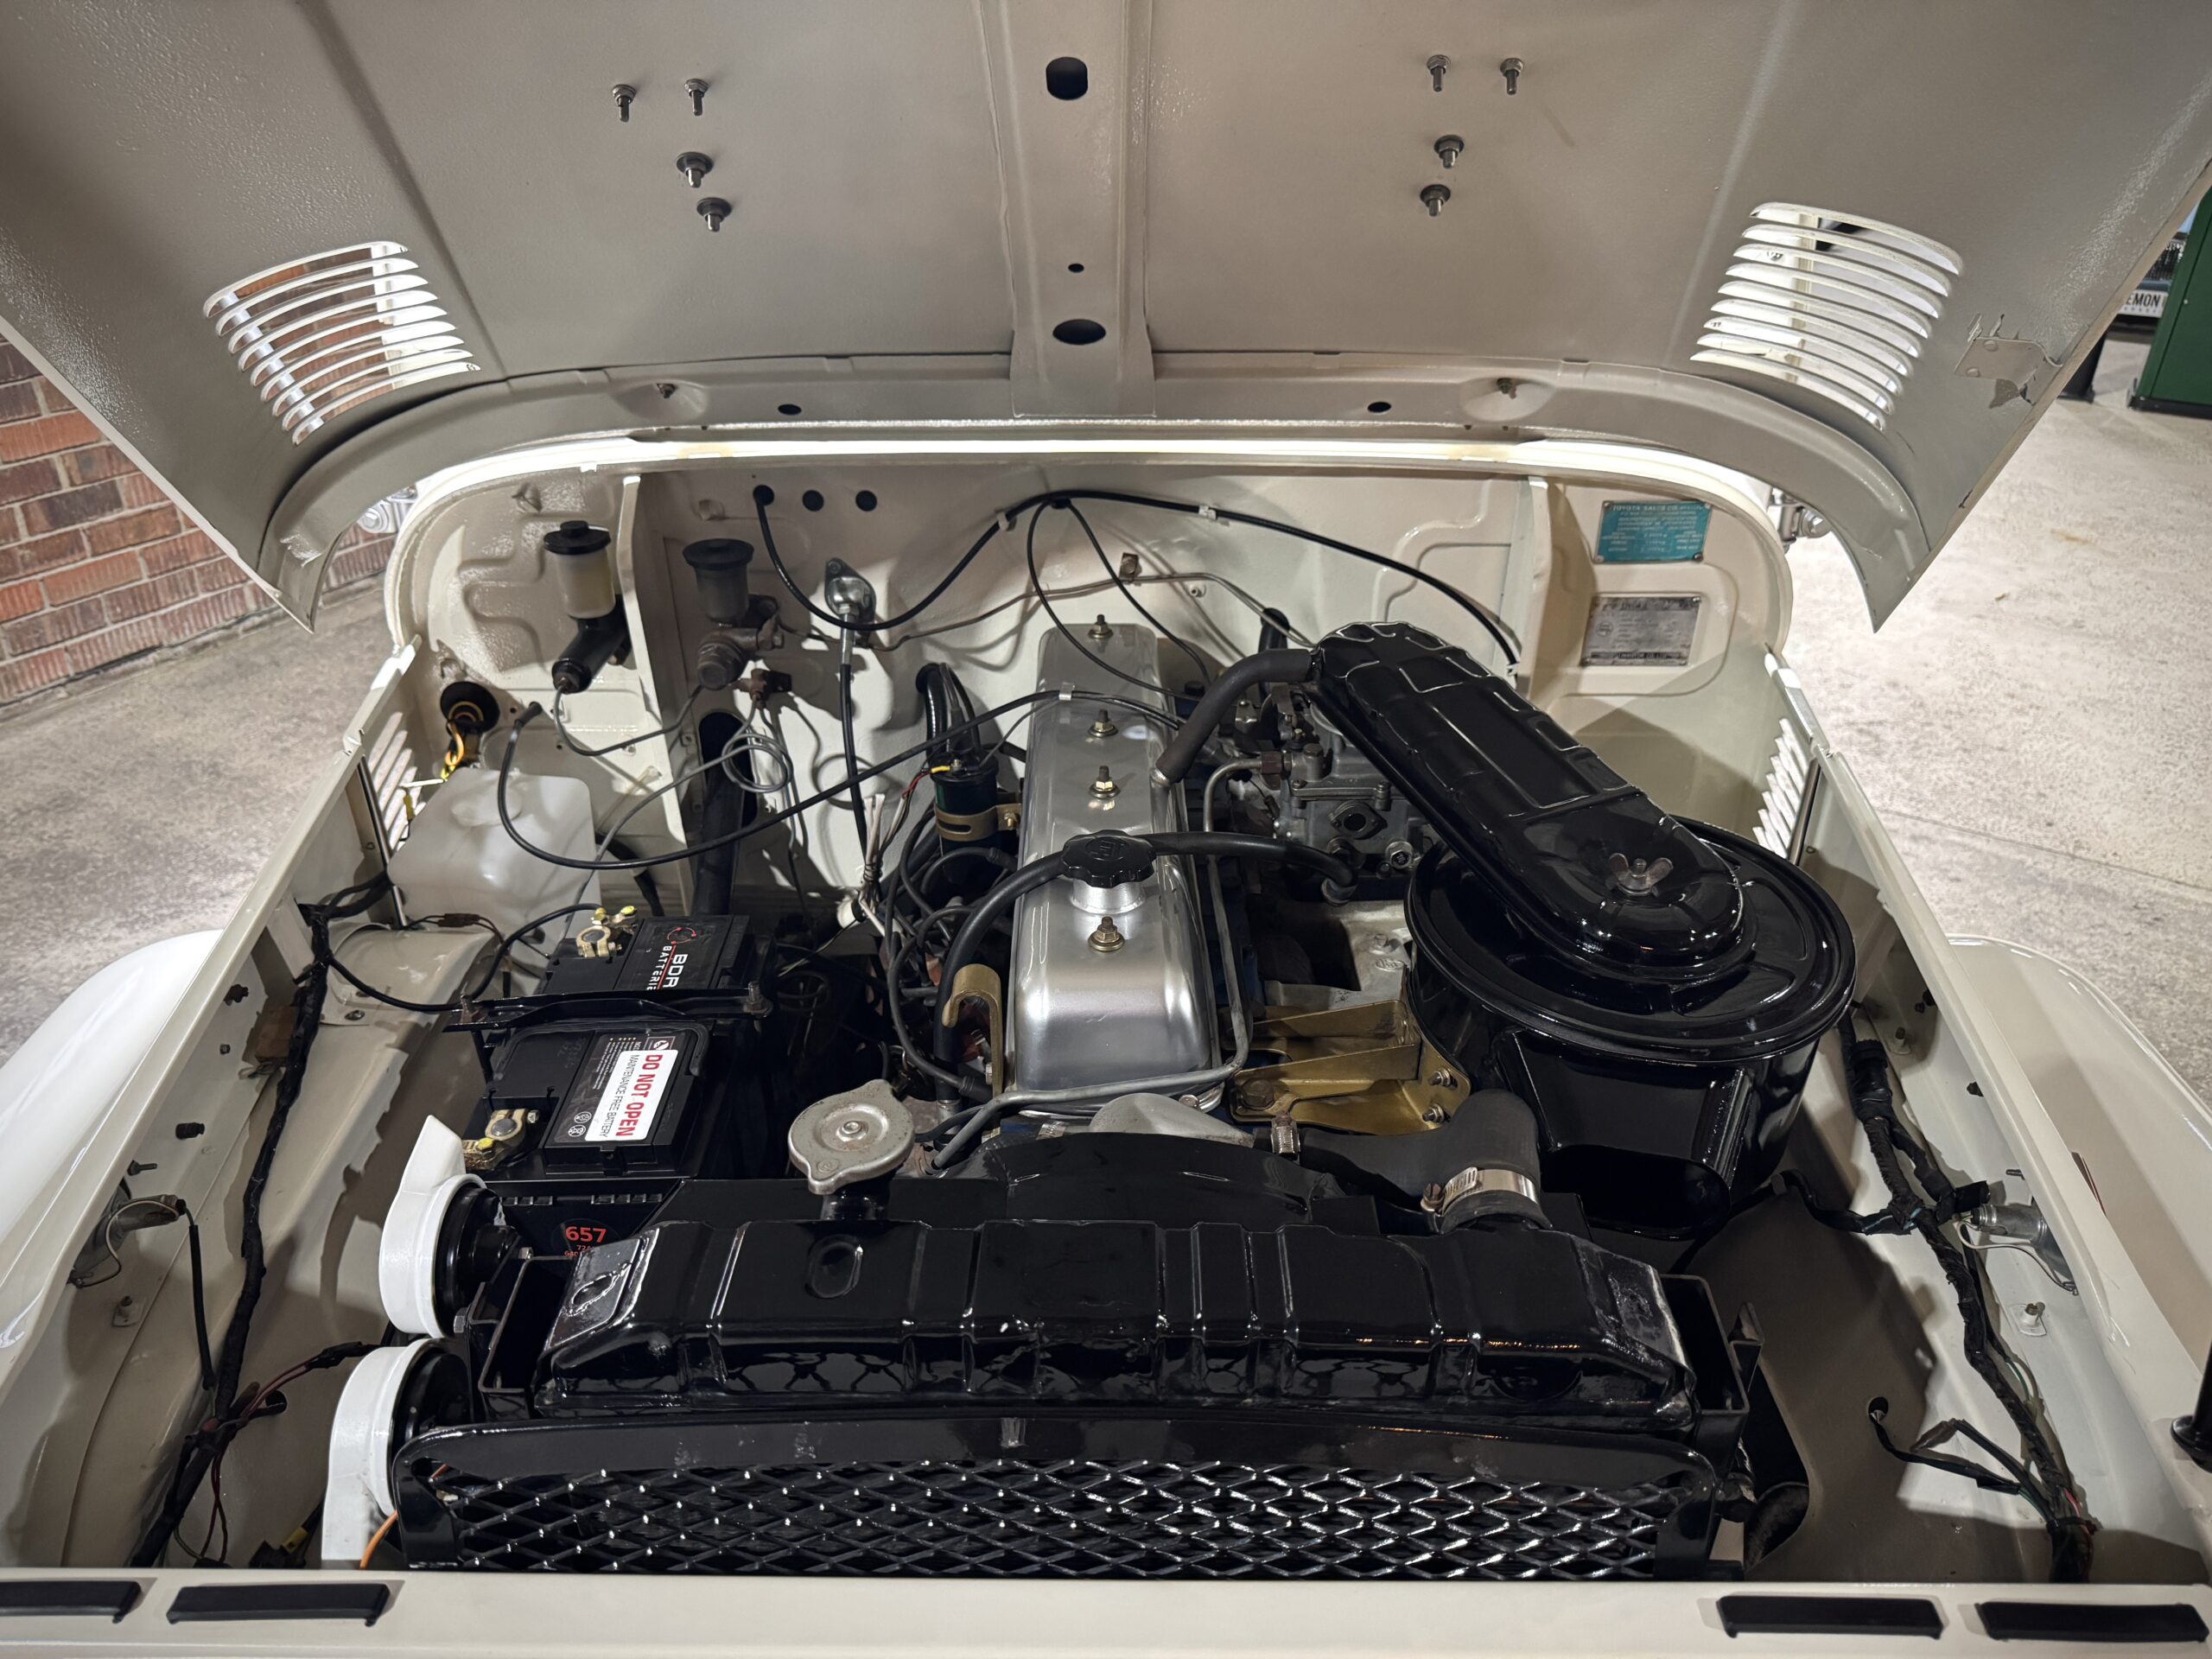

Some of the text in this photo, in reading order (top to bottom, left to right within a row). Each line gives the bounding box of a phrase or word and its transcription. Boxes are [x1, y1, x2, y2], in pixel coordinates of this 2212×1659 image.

[663, 954, 689, 988] BDR
[599, 1054, 640, 1137] MAINTENANCE FREE BATTERY
[615, 1054, 663, 1136] DO NOT OPEN
[566, 1226, 606, 1243] 657
